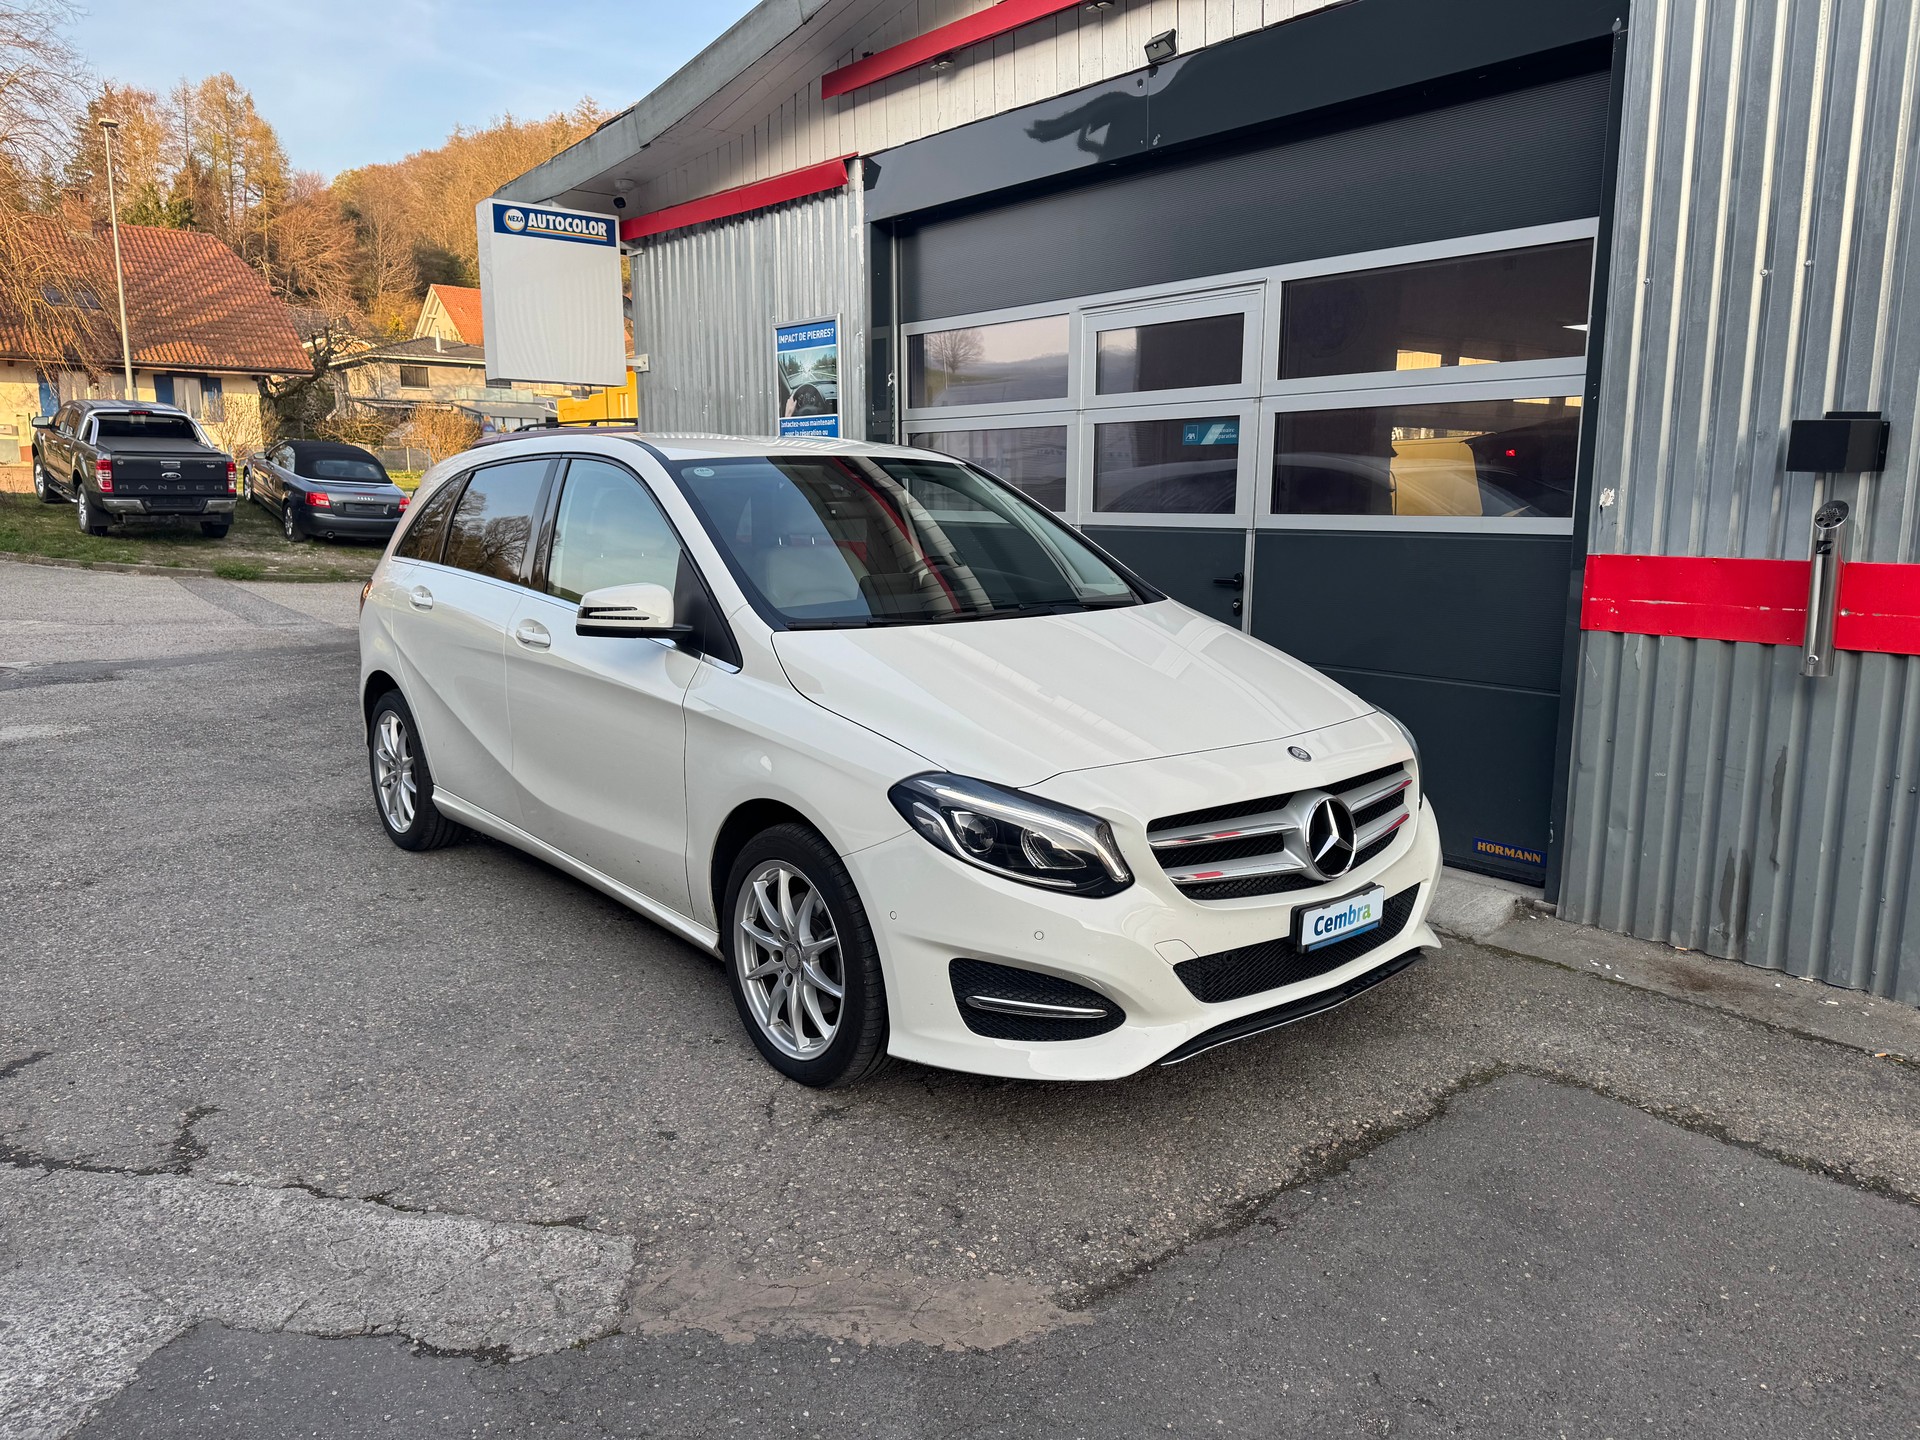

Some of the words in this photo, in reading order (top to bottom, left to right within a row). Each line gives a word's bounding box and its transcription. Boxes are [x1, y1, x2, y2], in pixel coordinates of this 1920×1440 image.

[507, 213, 524, 223] NEXA
[527, 212, 608, 236] AUTOCOLOR
[778, 333, 798, 343] IMPACT
[799, 331, 806, 341] DE
[807, 328, 834, 340] PIERRES?
[1477, 841, 1541, 864] HÖRMANN
[1313, 903, 1372, 936] Cembra
